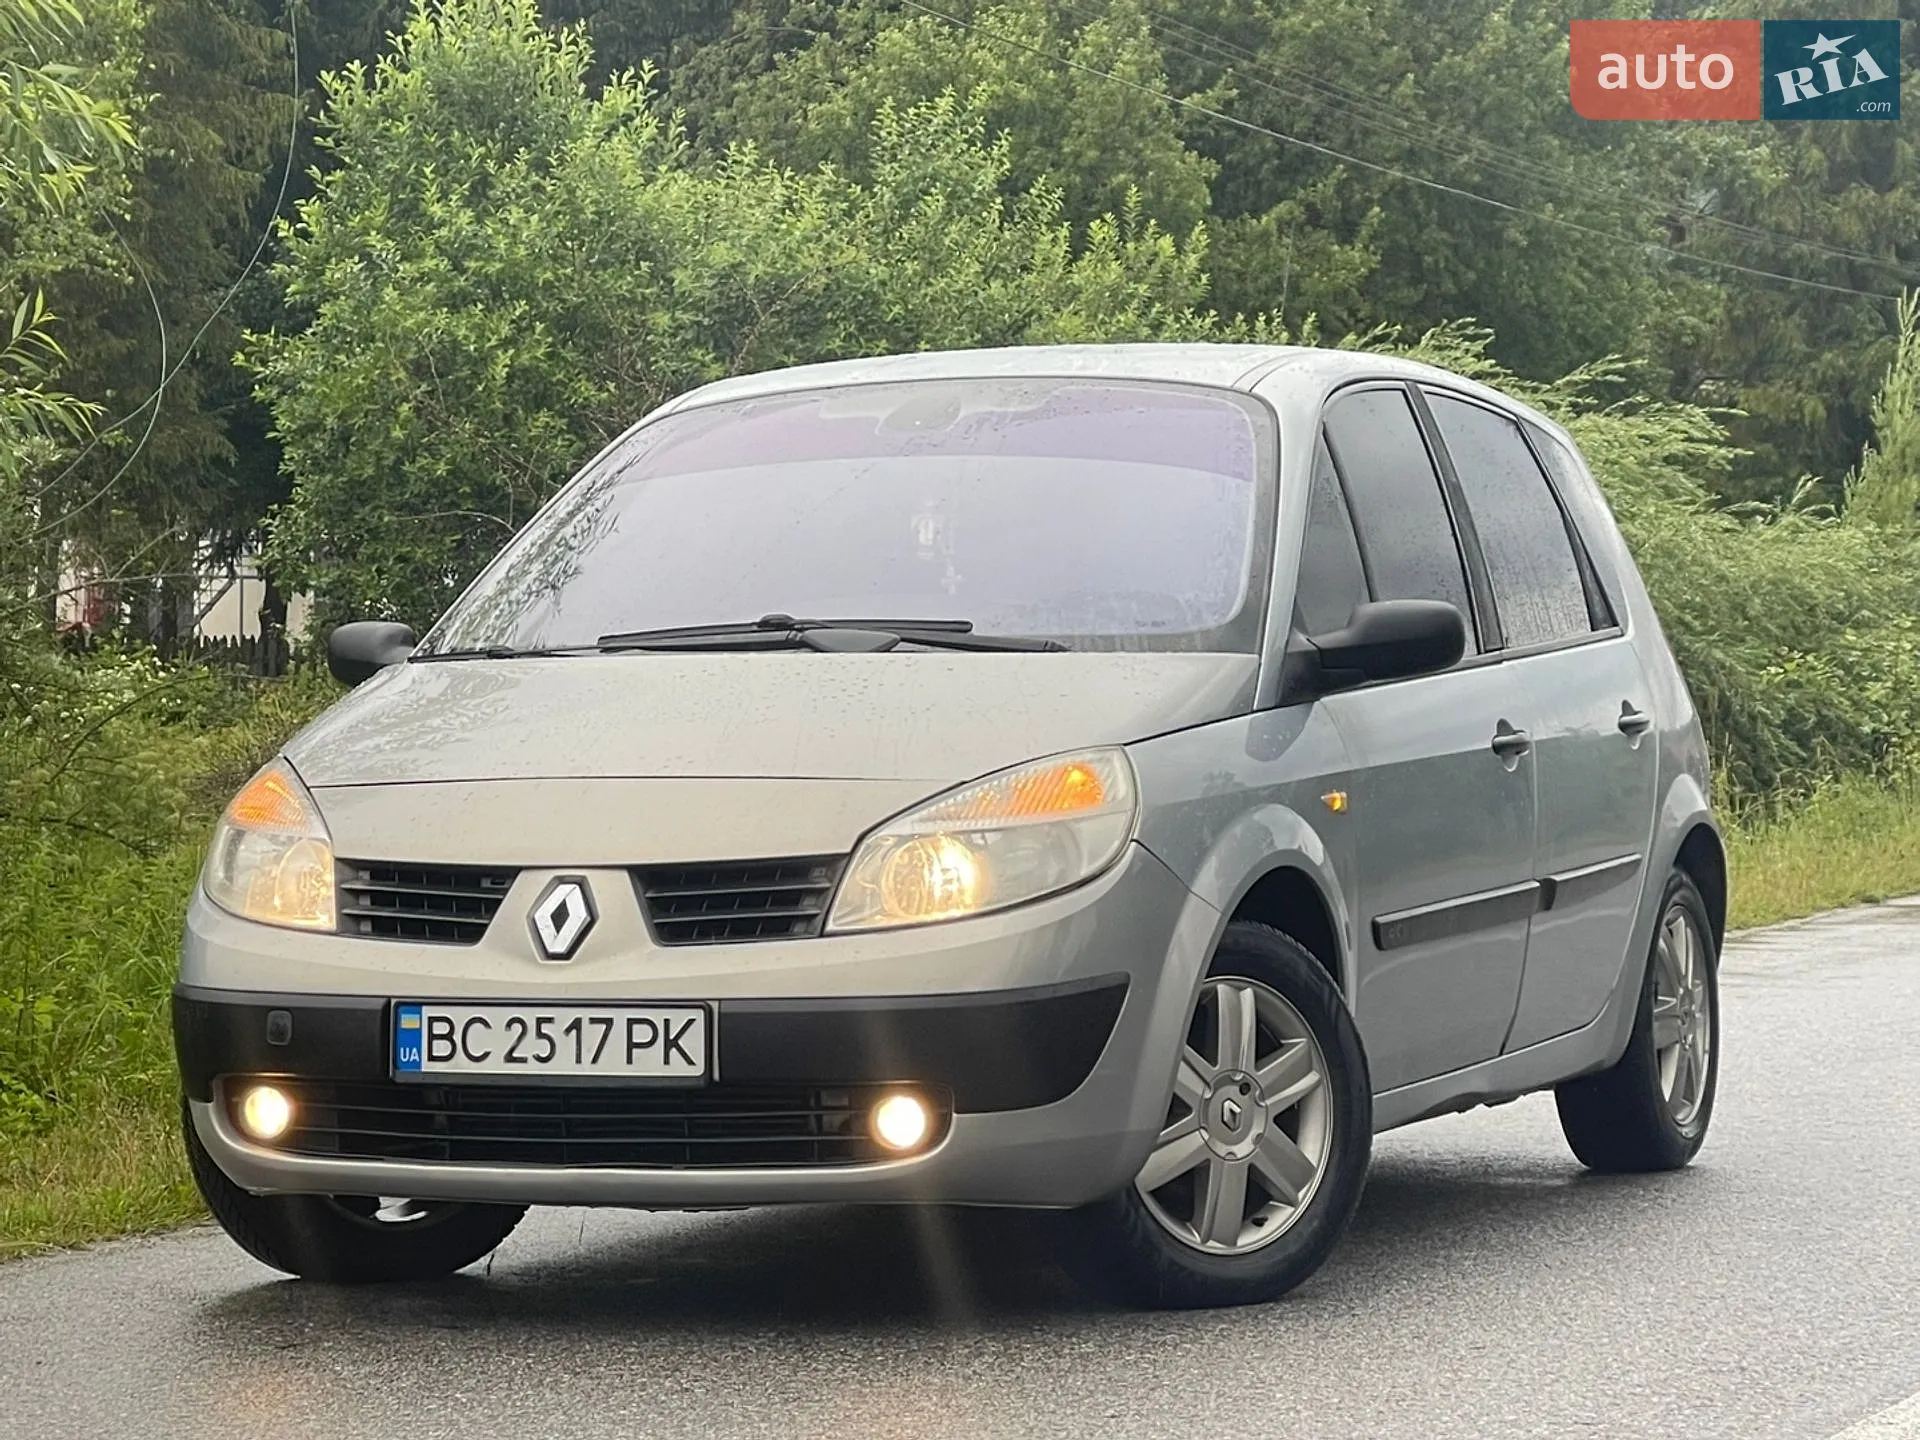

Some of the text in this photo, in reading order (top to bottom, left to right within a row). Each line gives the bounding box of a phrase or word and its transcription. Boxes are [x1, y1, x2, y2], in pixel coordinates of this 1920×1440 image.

[400, 1048, 421, 1062] UA
[427, 1016, 698, 1066] BC 2517 PK
